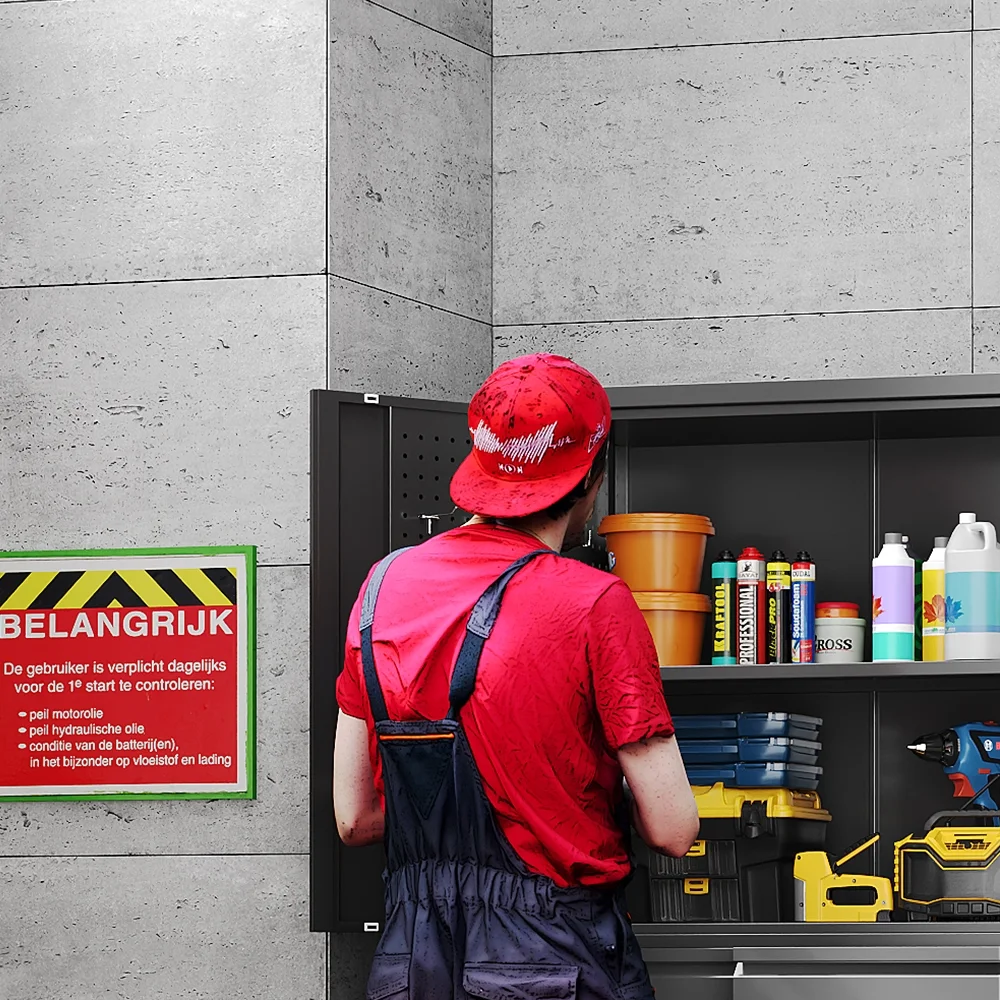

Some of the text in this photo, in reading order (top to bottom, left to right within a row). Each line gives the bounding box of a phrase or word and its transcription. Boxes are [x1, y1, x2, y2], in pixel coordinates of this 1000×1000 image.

[0, 609, 233, 639] BELANGRIJK
[713, 583, 725, 652] KRAFTOOL
[739, 586, 754, 664] PROFESSIONAL
[815, 635, 853, 651] ROSS
[3, 659, 227, 678] De gebruiker is verplicht dagelijks
[14, 683, 44, 693] voor
[47, 680, 65, 693] de
[85, 680, 115, 693] start
[119, 679, 132, 691] te
[135, 678, 215, 691] controleren:
[29, 708, 104, 722] peil motorolie
[29, 723, 145, 738] peil hydraulische olie
[29, 738, 179, 752] conditie van de batterij(en),
[30, 754, 232, 769] in het bijzonder op vloeistof en lading
